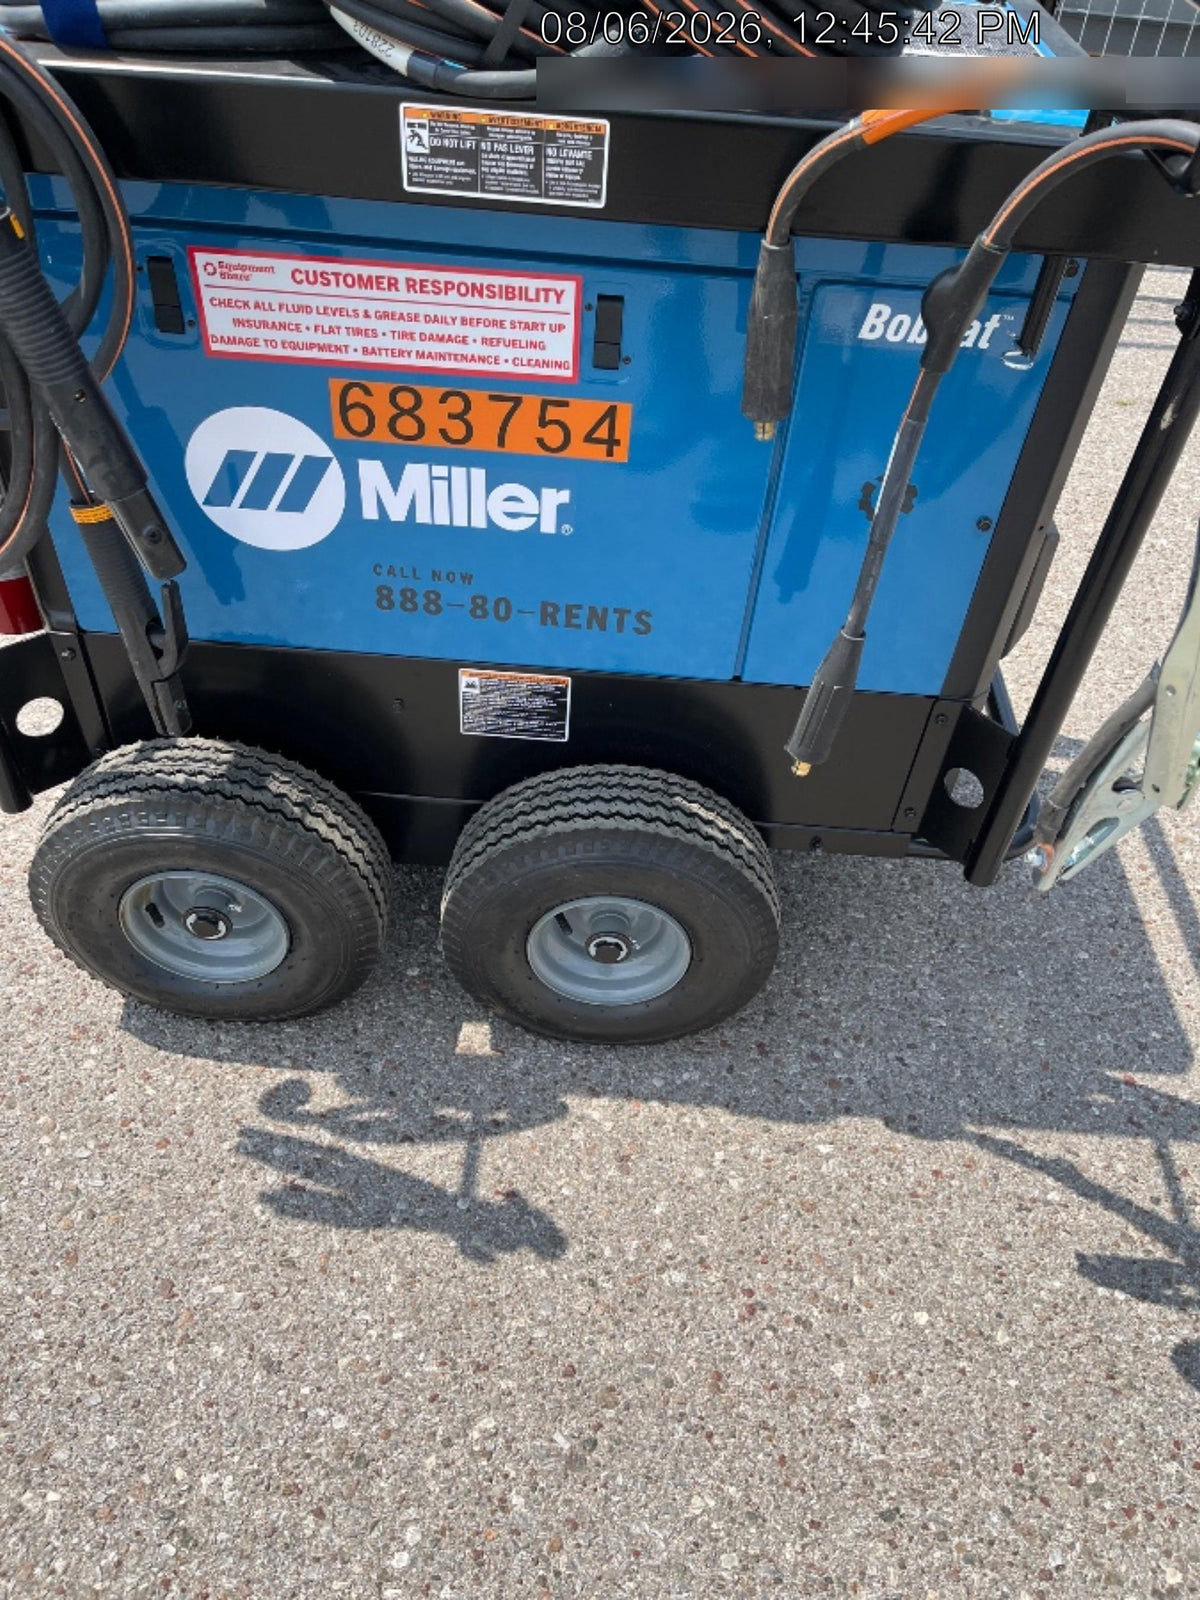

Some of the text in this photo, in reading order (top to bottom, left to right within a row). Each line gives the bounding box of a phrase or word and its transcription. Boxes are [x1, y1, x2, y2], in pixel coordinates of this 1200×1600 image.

[430, 137, 476, 150] DO NOT LIFT
[218, 261, 276, 275] Equipment
[290, 268, 566, 305] CUSTOMER RESPONSIBILITY
[209, 297, 566, 333] CHECK ALL FLUID LEVELS & GREASE DAILY BEFORE START UP
[858, 303, 1002, 350] Bobat
[210, 334, 570, 371] DAMAGE TO EQUIPMENT BATTERY MAINTENANCE CLEANING
[232, 317, 546, 351] INSURANCE FLAT TIRES TIRE DAMAGE REFUELING
[340, 381, 621, 458] 683754
[358, 458, 571, 535] Miller
[373, 563, 474, 586] CALL NOW
[375, 584, 653, 636] 888-80-RENTS
